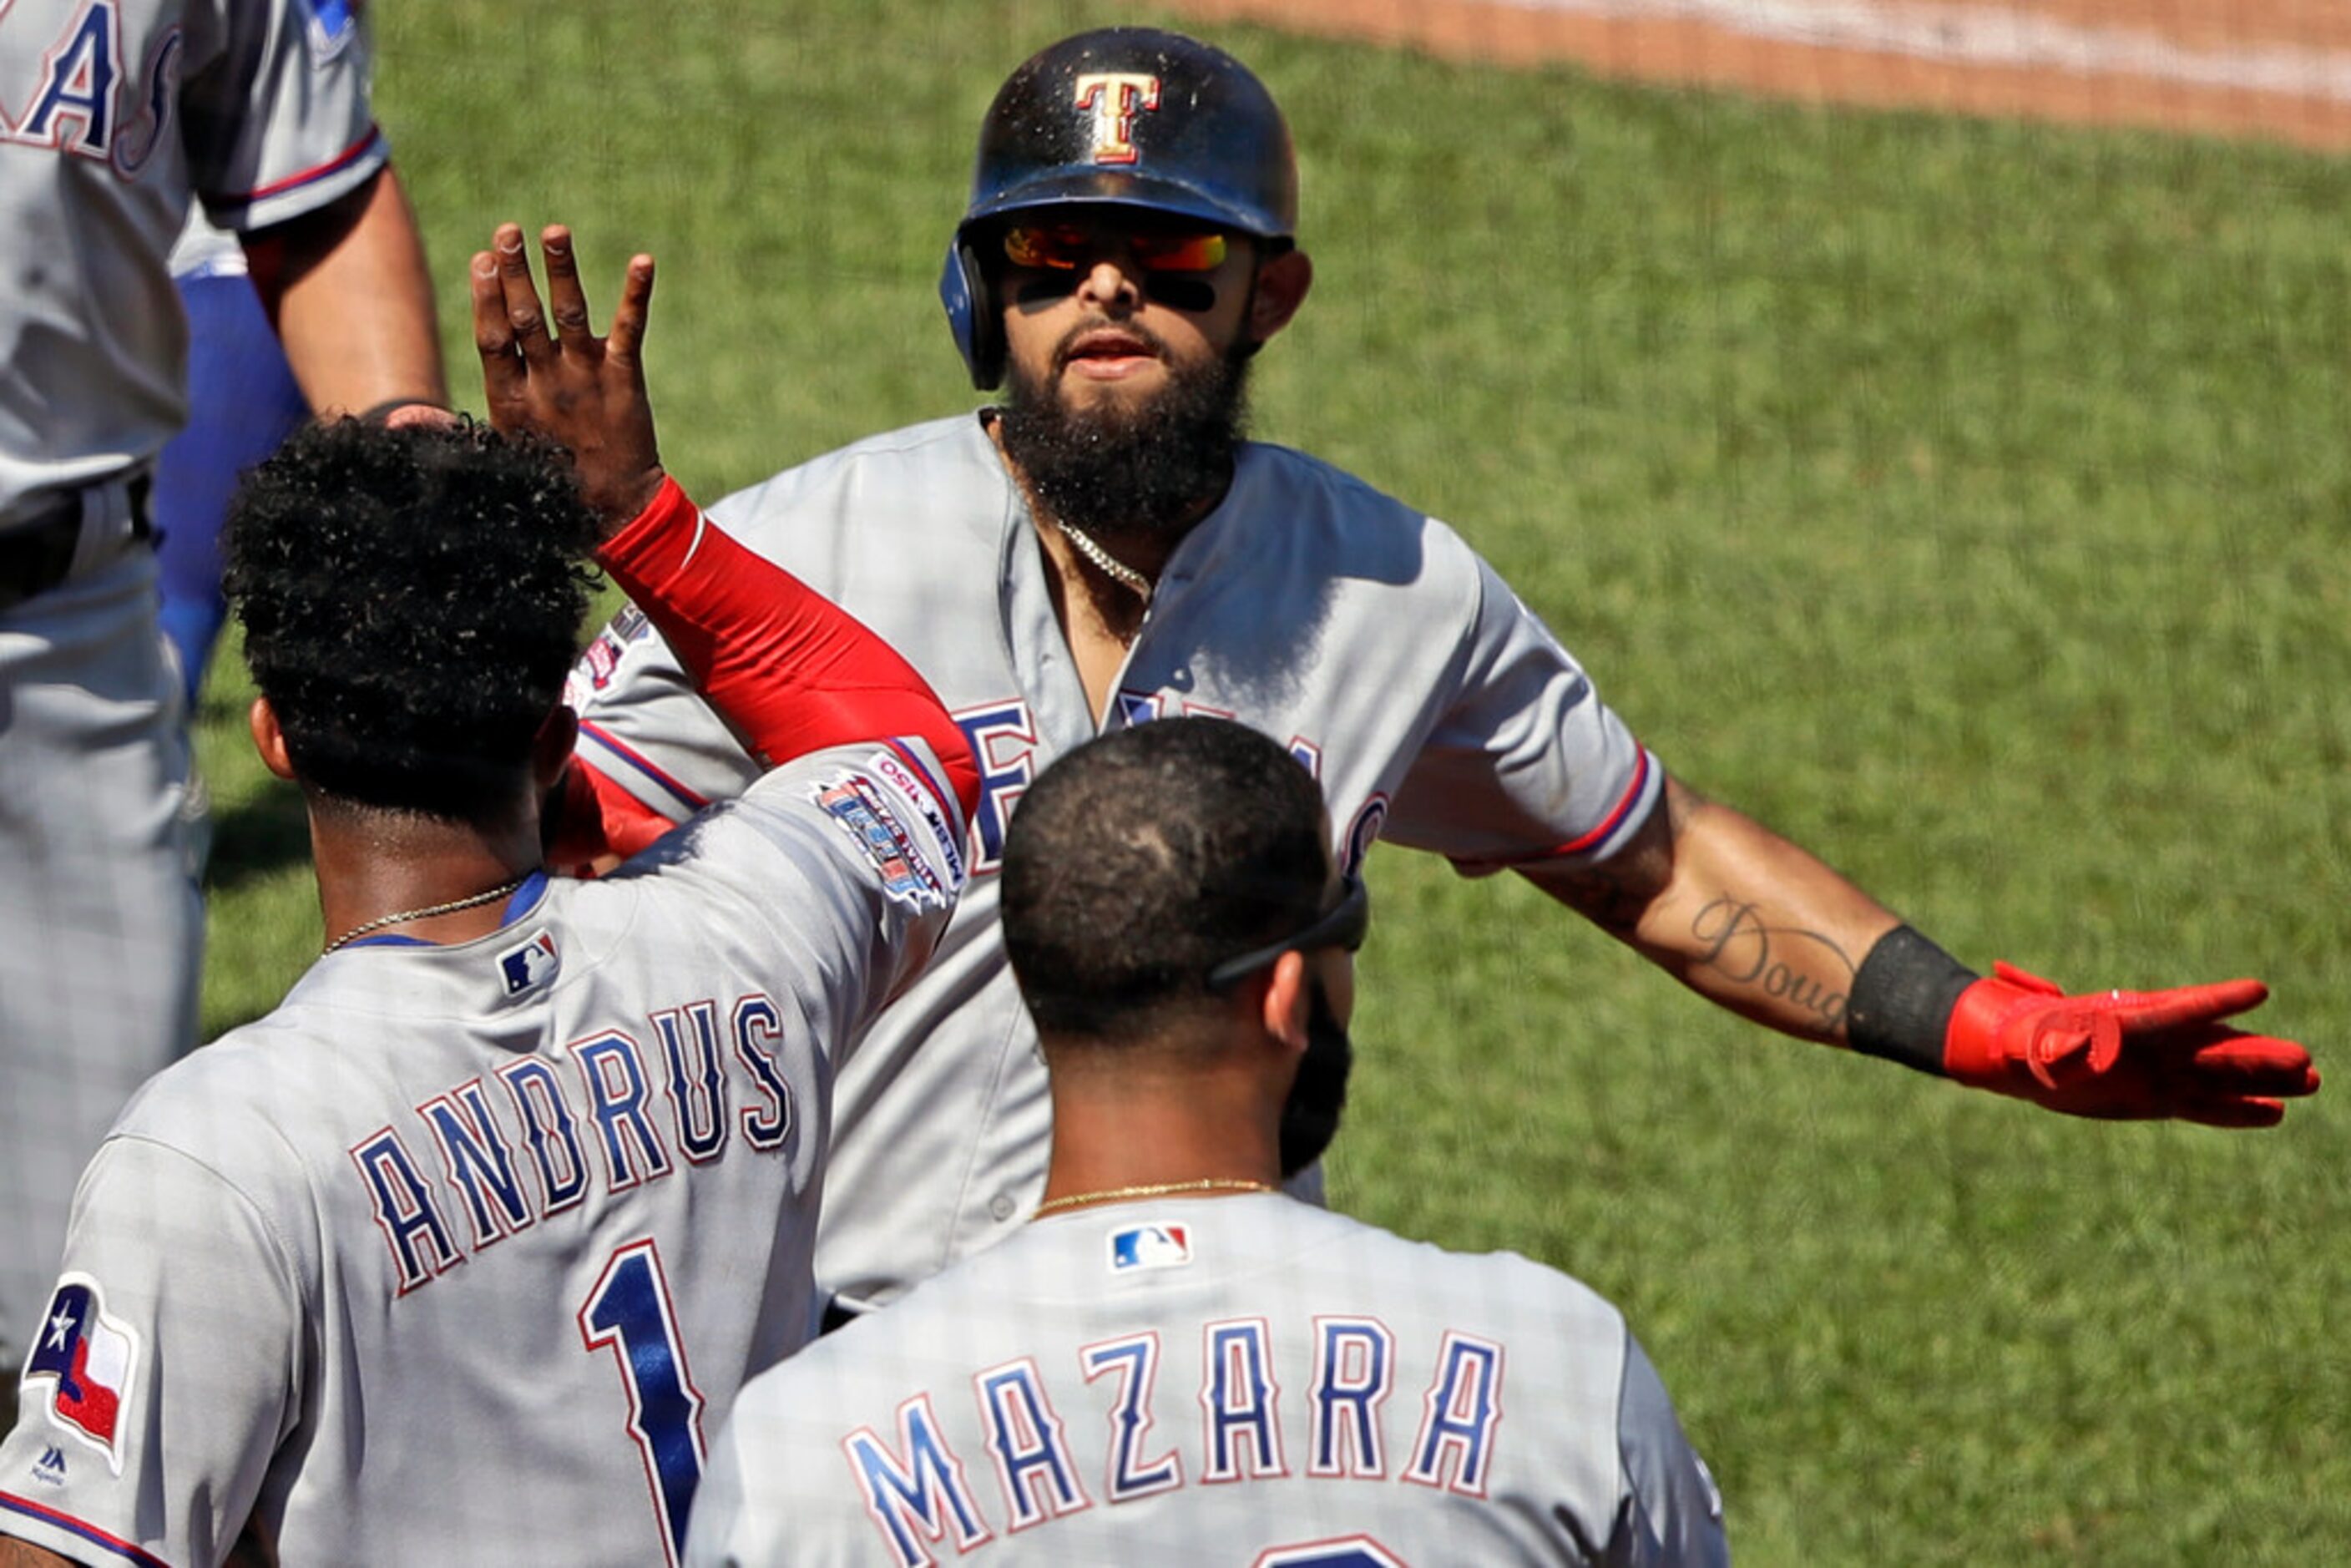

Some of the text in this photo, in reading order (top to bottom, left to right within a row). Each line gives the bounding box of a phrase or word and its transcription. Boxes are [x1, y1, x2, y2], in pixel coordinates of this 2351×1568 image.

[1074, 73, 1161, 165] T
[348, 994, 791, 1298] ANDRUS
[578, 1238, 708, 1568] 1
[840, 1315, 1504, 1568] MAZARA
